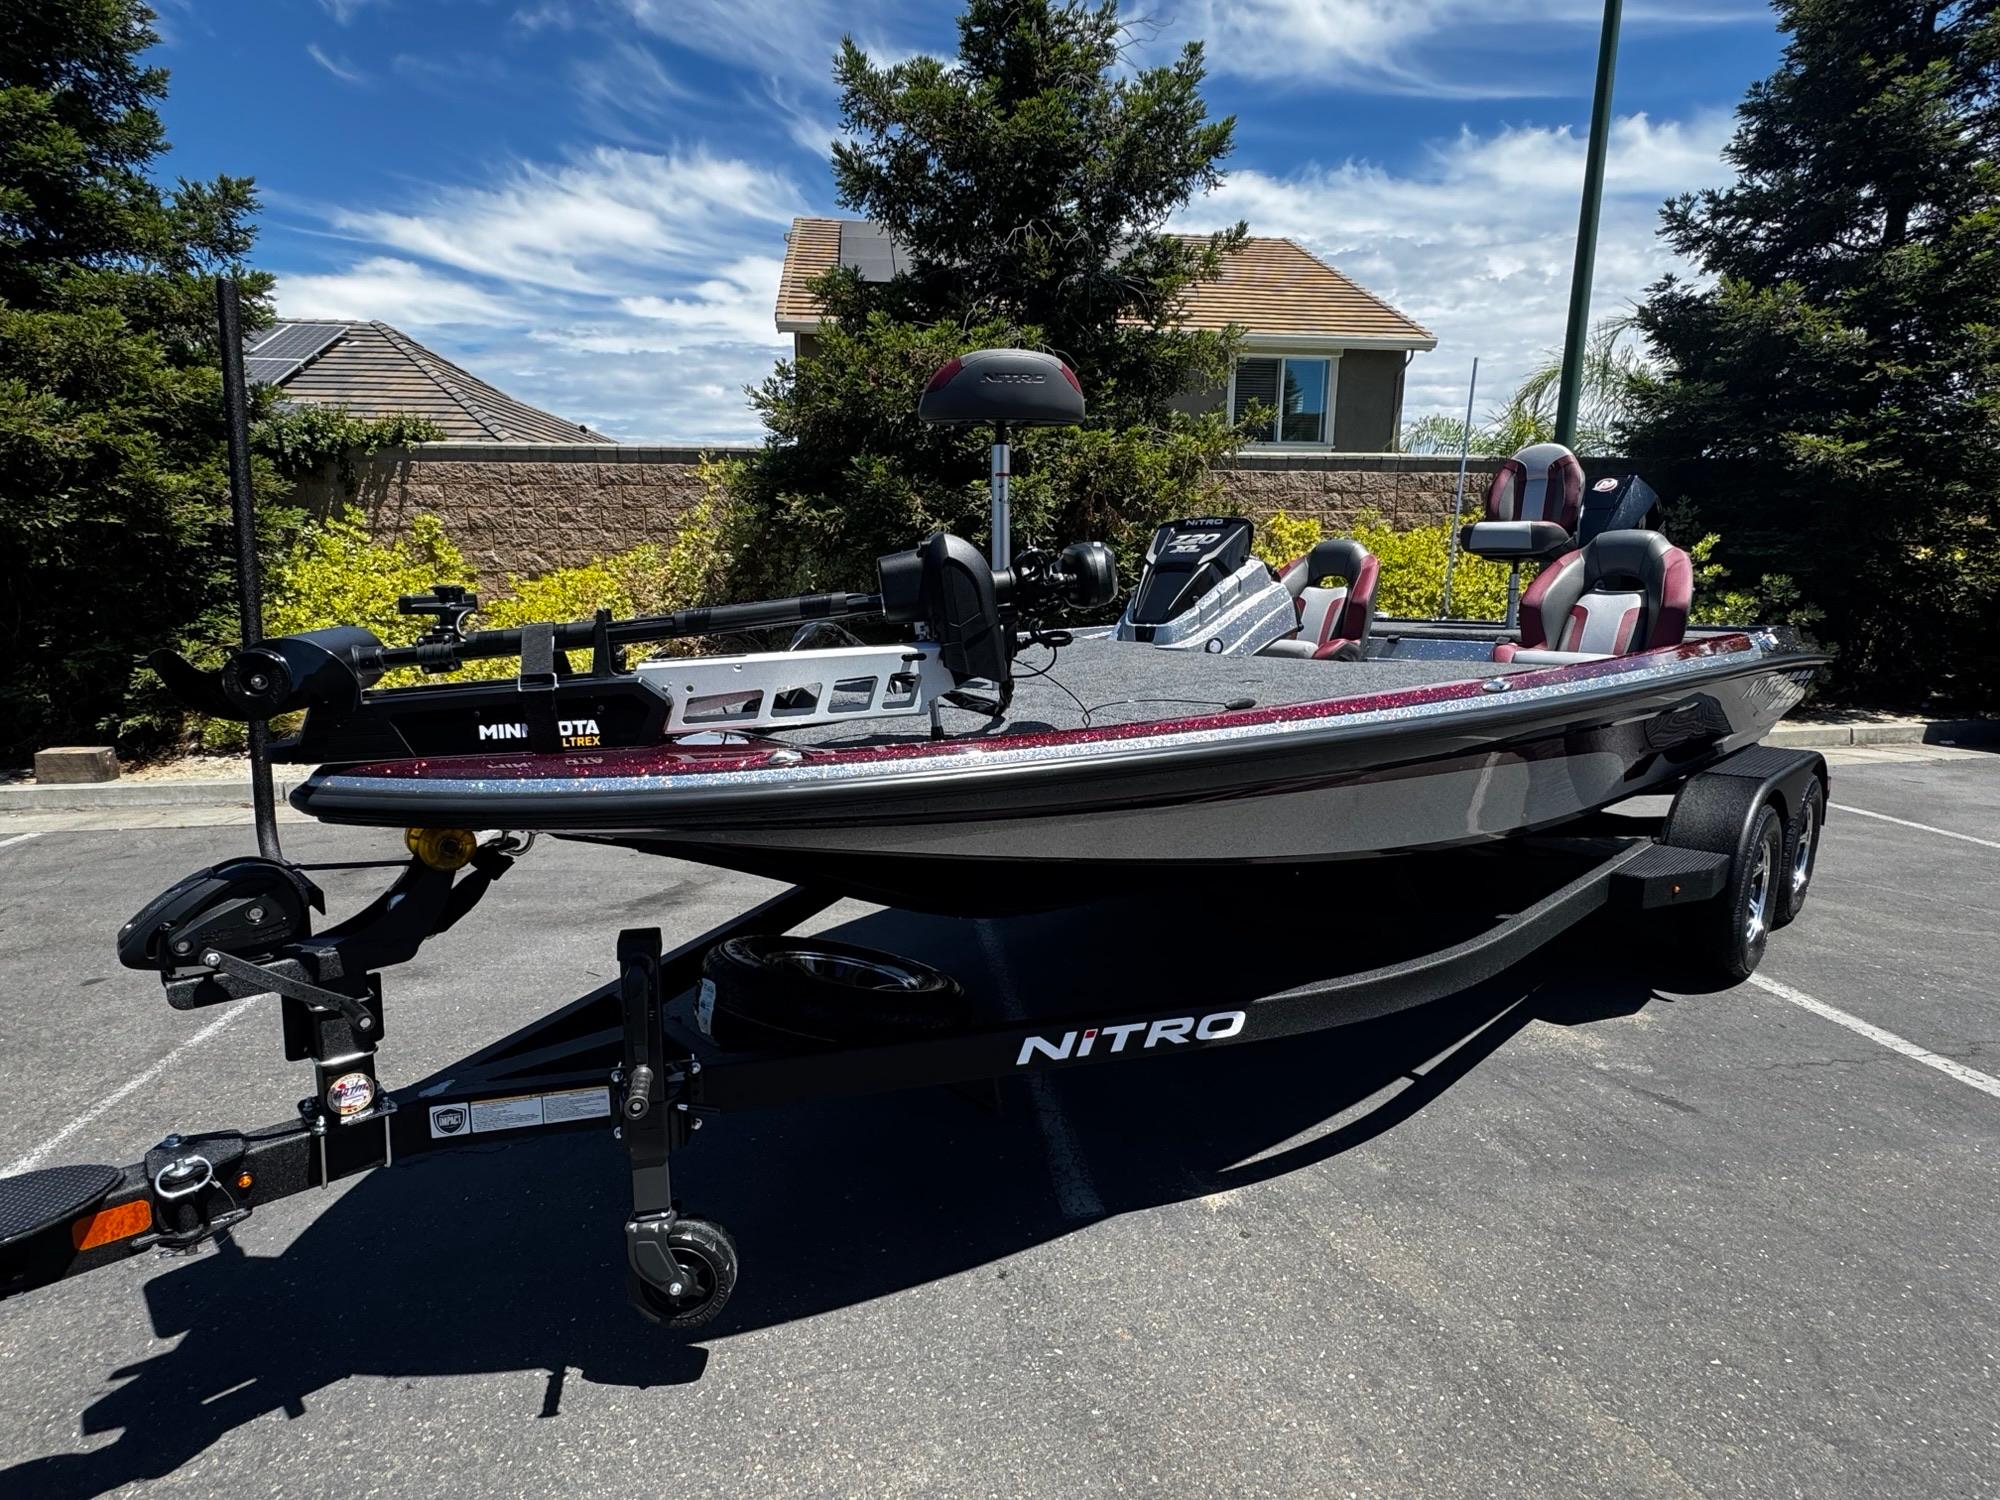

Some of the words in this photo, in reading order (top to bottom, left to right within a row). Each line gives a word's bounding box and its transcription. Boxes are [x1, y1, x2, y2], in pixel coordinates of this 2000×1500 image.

[1167, 533, 1221, 546] Z20
[1169, 545, 1201, 553] XL
[558, 719, 600, 736] OTA
[562, 736, 601, 747] LTREX
[438, 1114, 462, 1127] IMPACT
